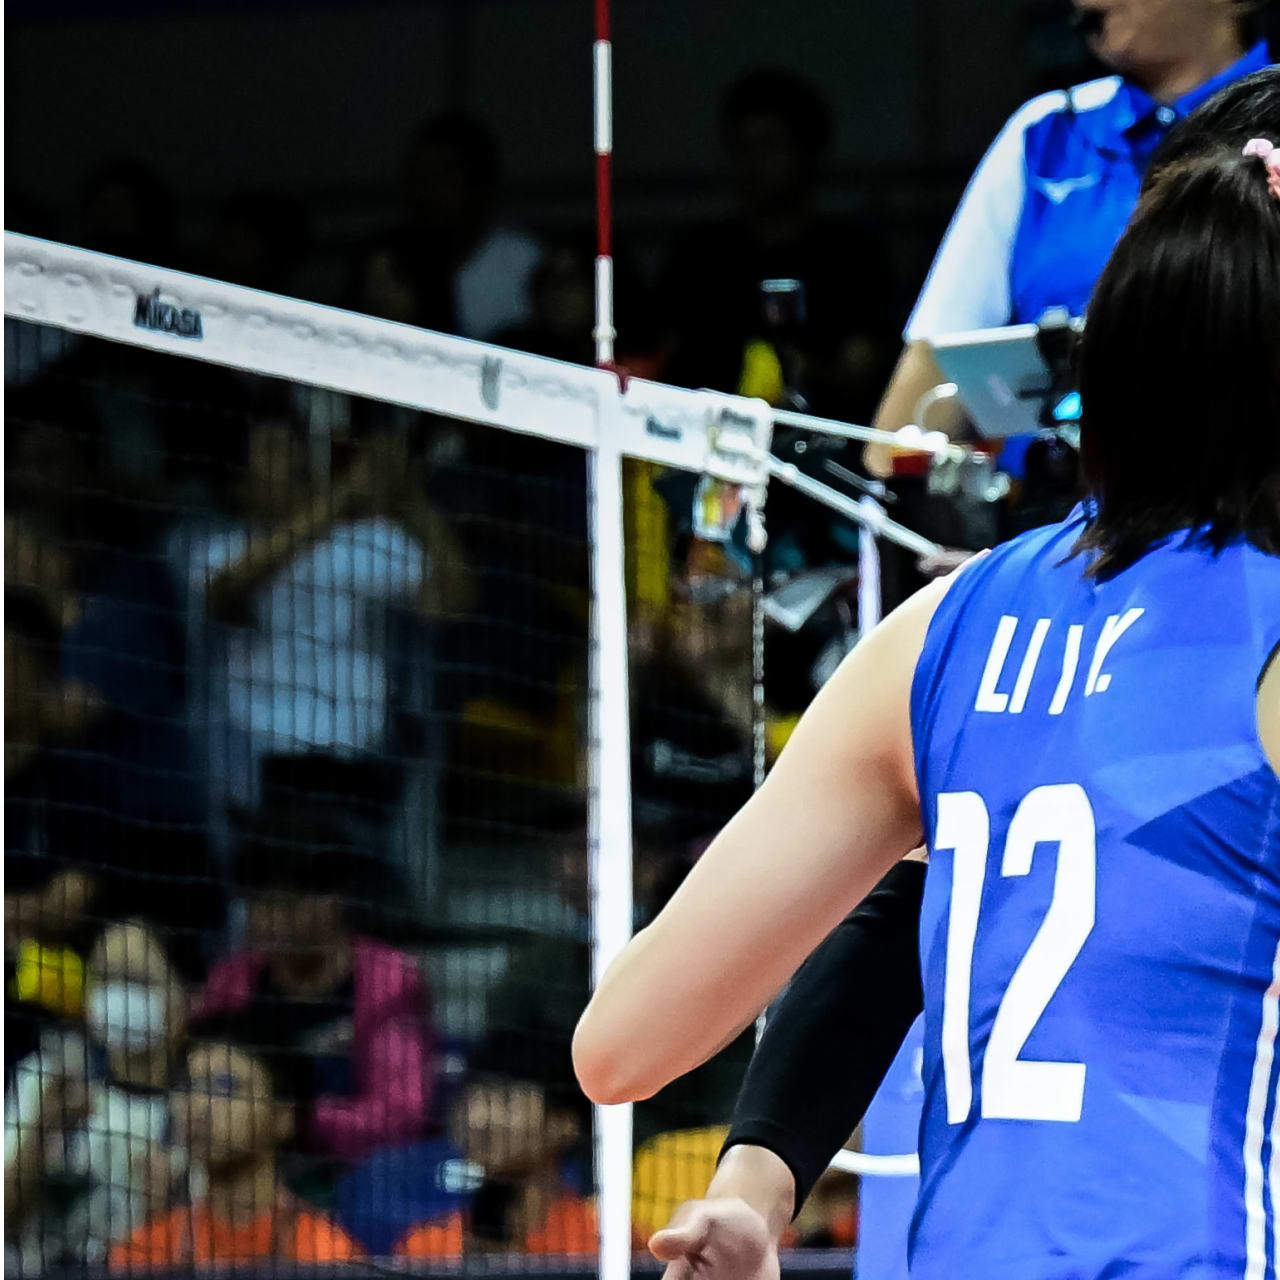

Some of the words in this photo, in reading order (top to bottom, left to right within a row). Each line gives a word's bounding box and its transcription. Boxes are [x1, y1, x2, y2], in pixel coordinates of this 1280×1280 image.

[133, 287, 204, 340] MIKASA
[974, 615, 1052, 714] LI
[934, 782, 1096, 1125] 12
